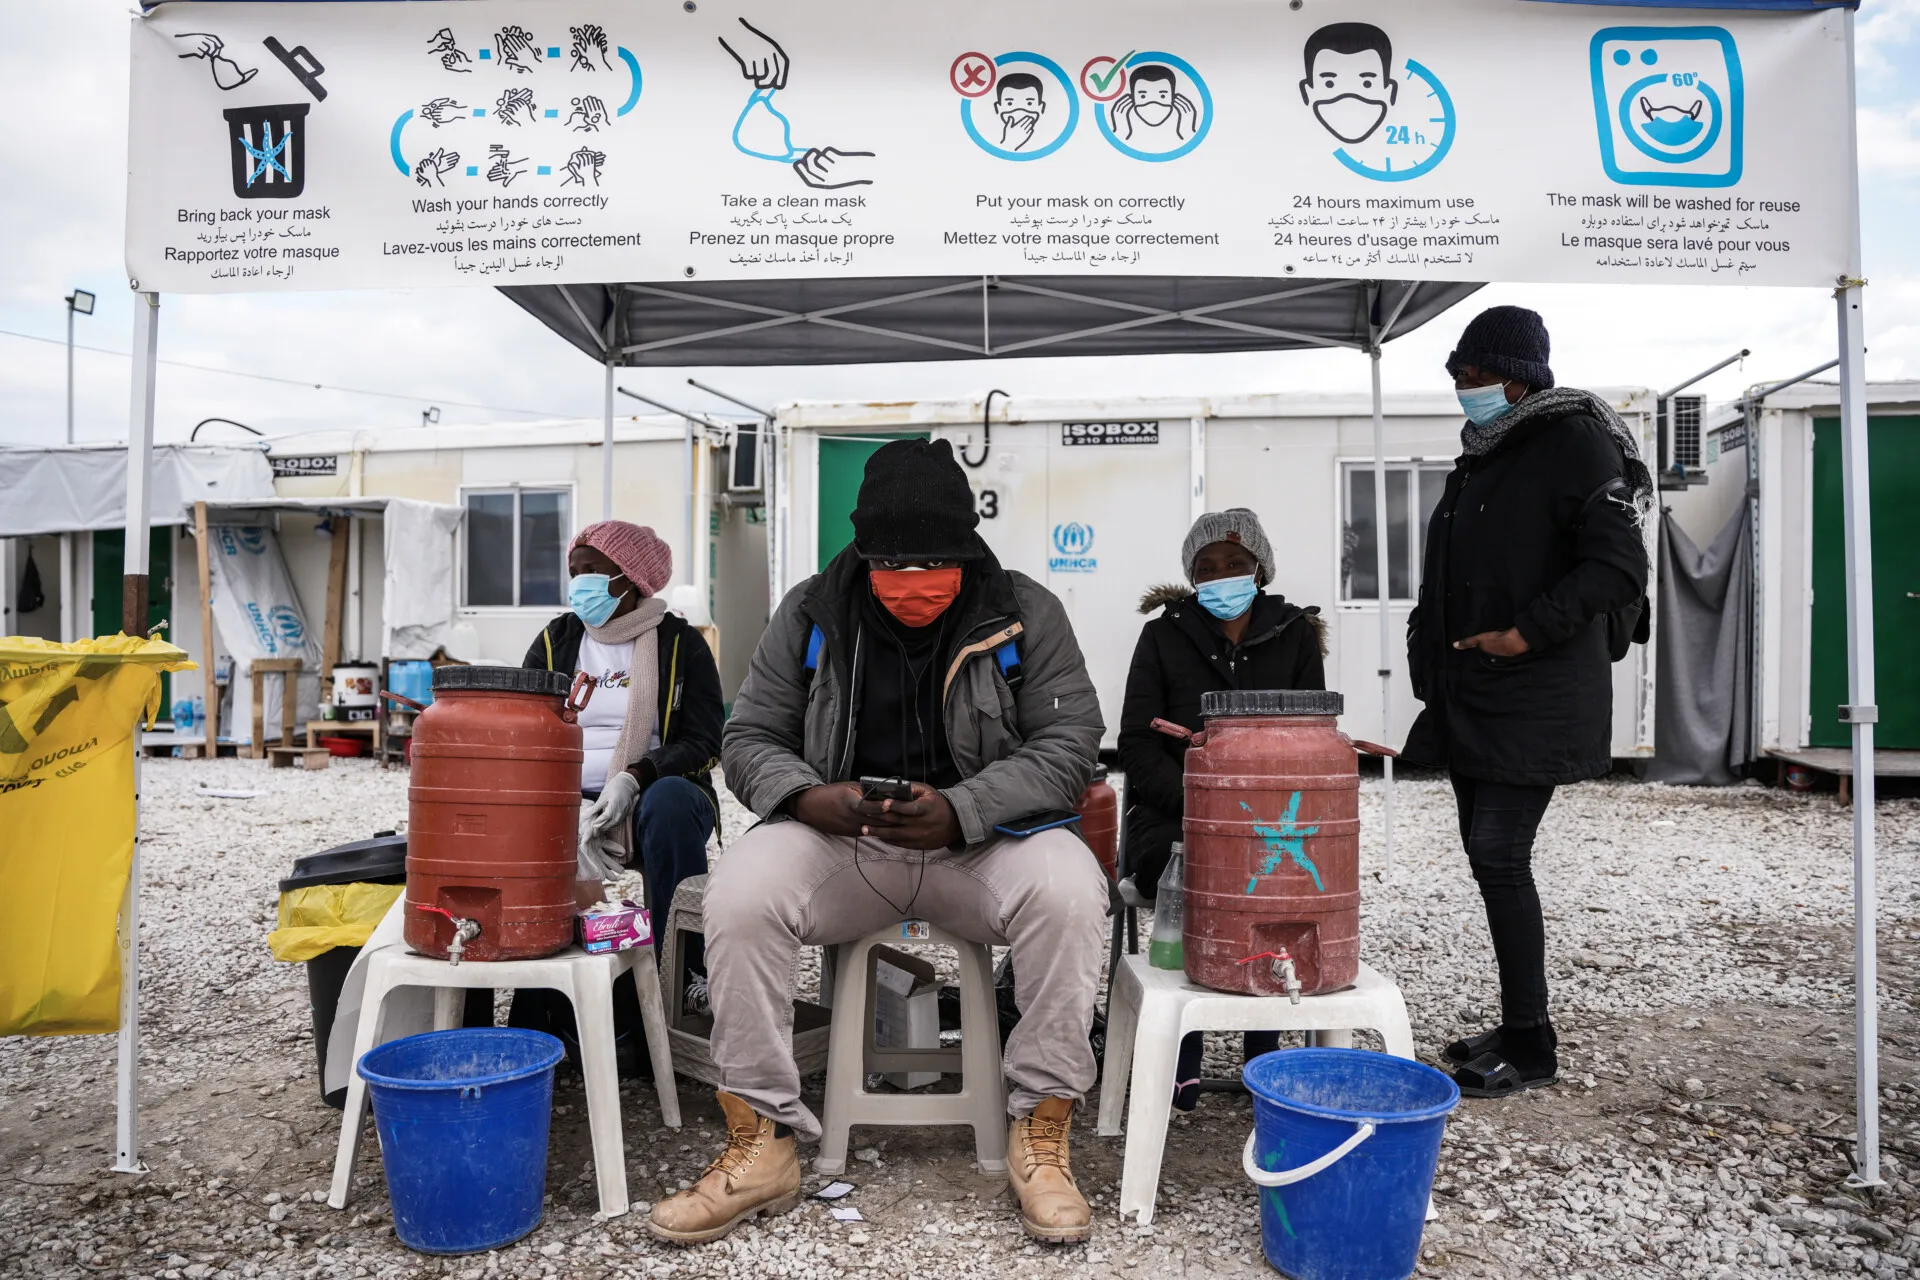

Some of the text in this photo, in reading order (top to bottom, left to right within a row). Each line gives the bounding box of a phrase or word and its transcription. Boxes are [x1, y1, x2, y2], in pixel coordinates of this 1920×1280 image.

[1385, 125, 1426, 145] 24 h
[412, 194, 609, 215] Wash your hands correctly
[721, 194, 866, 207] Take a clean mask
[976, 195, 1185, 211] Put your mask on correctly
[1293, 195, 1474, 209] 24 hours maximum use
[1546, 193, 1800, 212] The mask will be washed for reuse
[178, 206, 331, 226] Bring back your mask
[383, 232, 641, 255] Lavez-vous les mains correctement
[690, 231, 894, 248] Prenez un masque propre
[944, 231, 1219, 247] Mettez votre masque correctement
[1274, 232, 1499, 250] 24 heures d'usage maximum
[1562, 232, 1790, 254] Le masque sera lavé pour vous
[165, 246, 340, 264] Rapportez votre masque
[1063, 422, 1157, 436] ISOBOX
[1077, 436, 1101, 444] 210
[973, 490, 998, 519] 3
[1049, 557, 1098, 568] UNHCR
[247, 602, 278, 653] UNHCR
